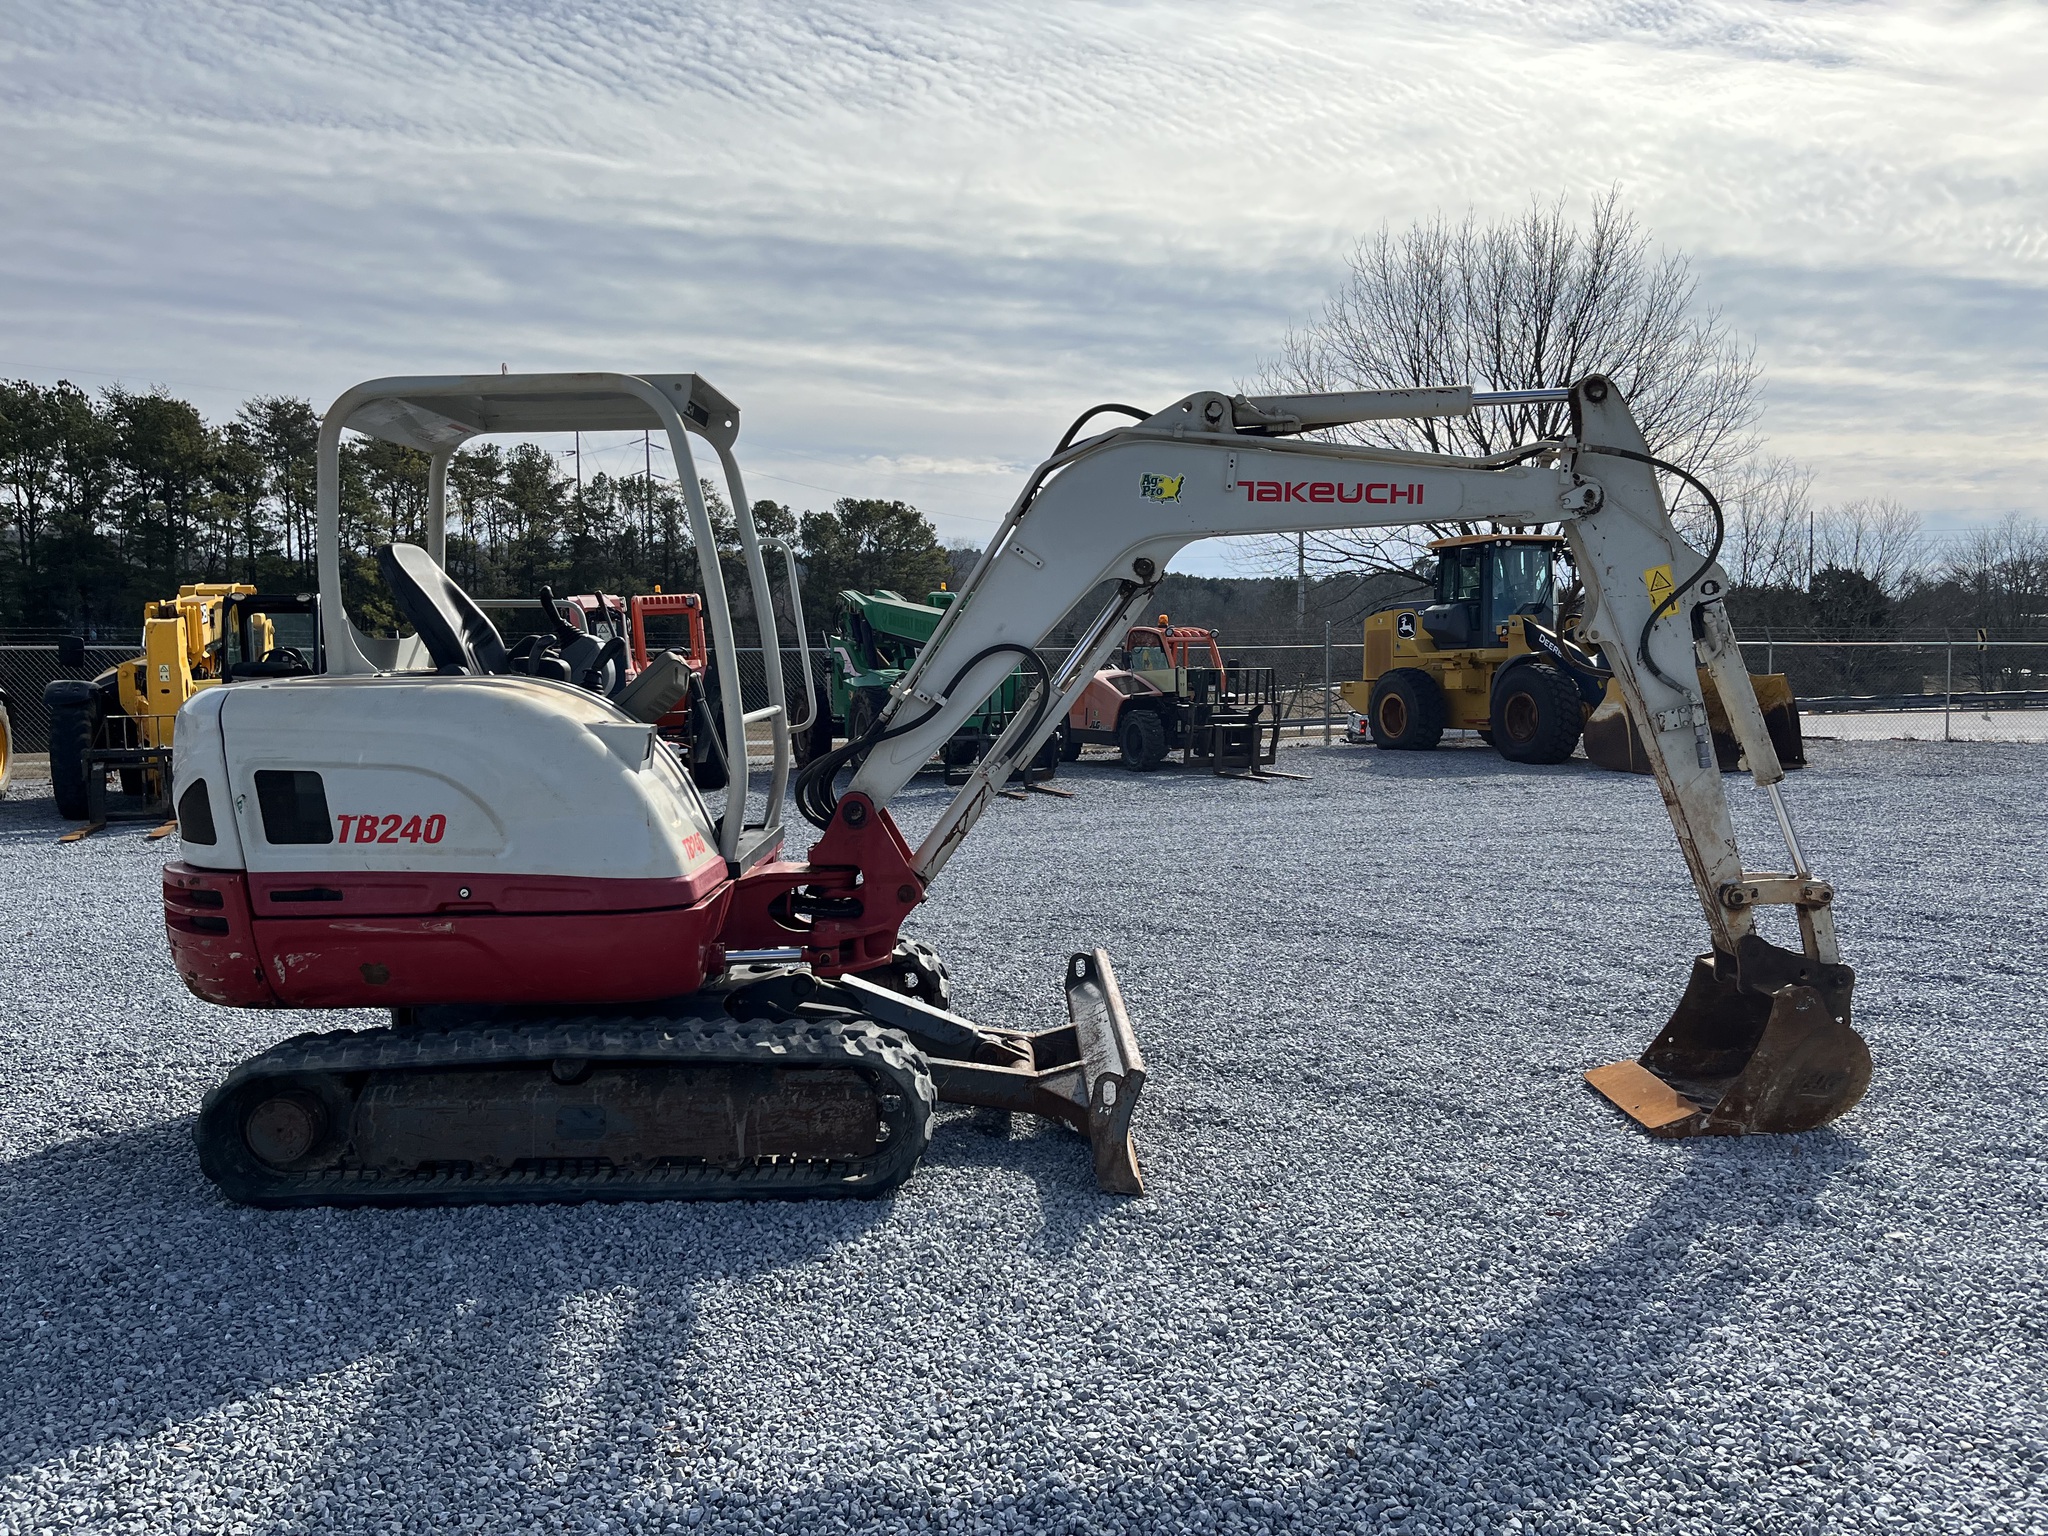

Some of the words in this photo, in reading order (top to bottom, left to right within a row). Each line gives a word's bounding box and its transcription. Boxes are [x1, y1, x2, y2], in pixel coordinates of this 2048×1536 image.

[1142, 475, 1163, 487] Ag-
[1142, 486, 1163, 496] Pro
[1237, 481, 1424, 505] TAKEUCHI
[1538, 633, 1562, 658] DEERE
[337, 814, 447, 844] TB240
